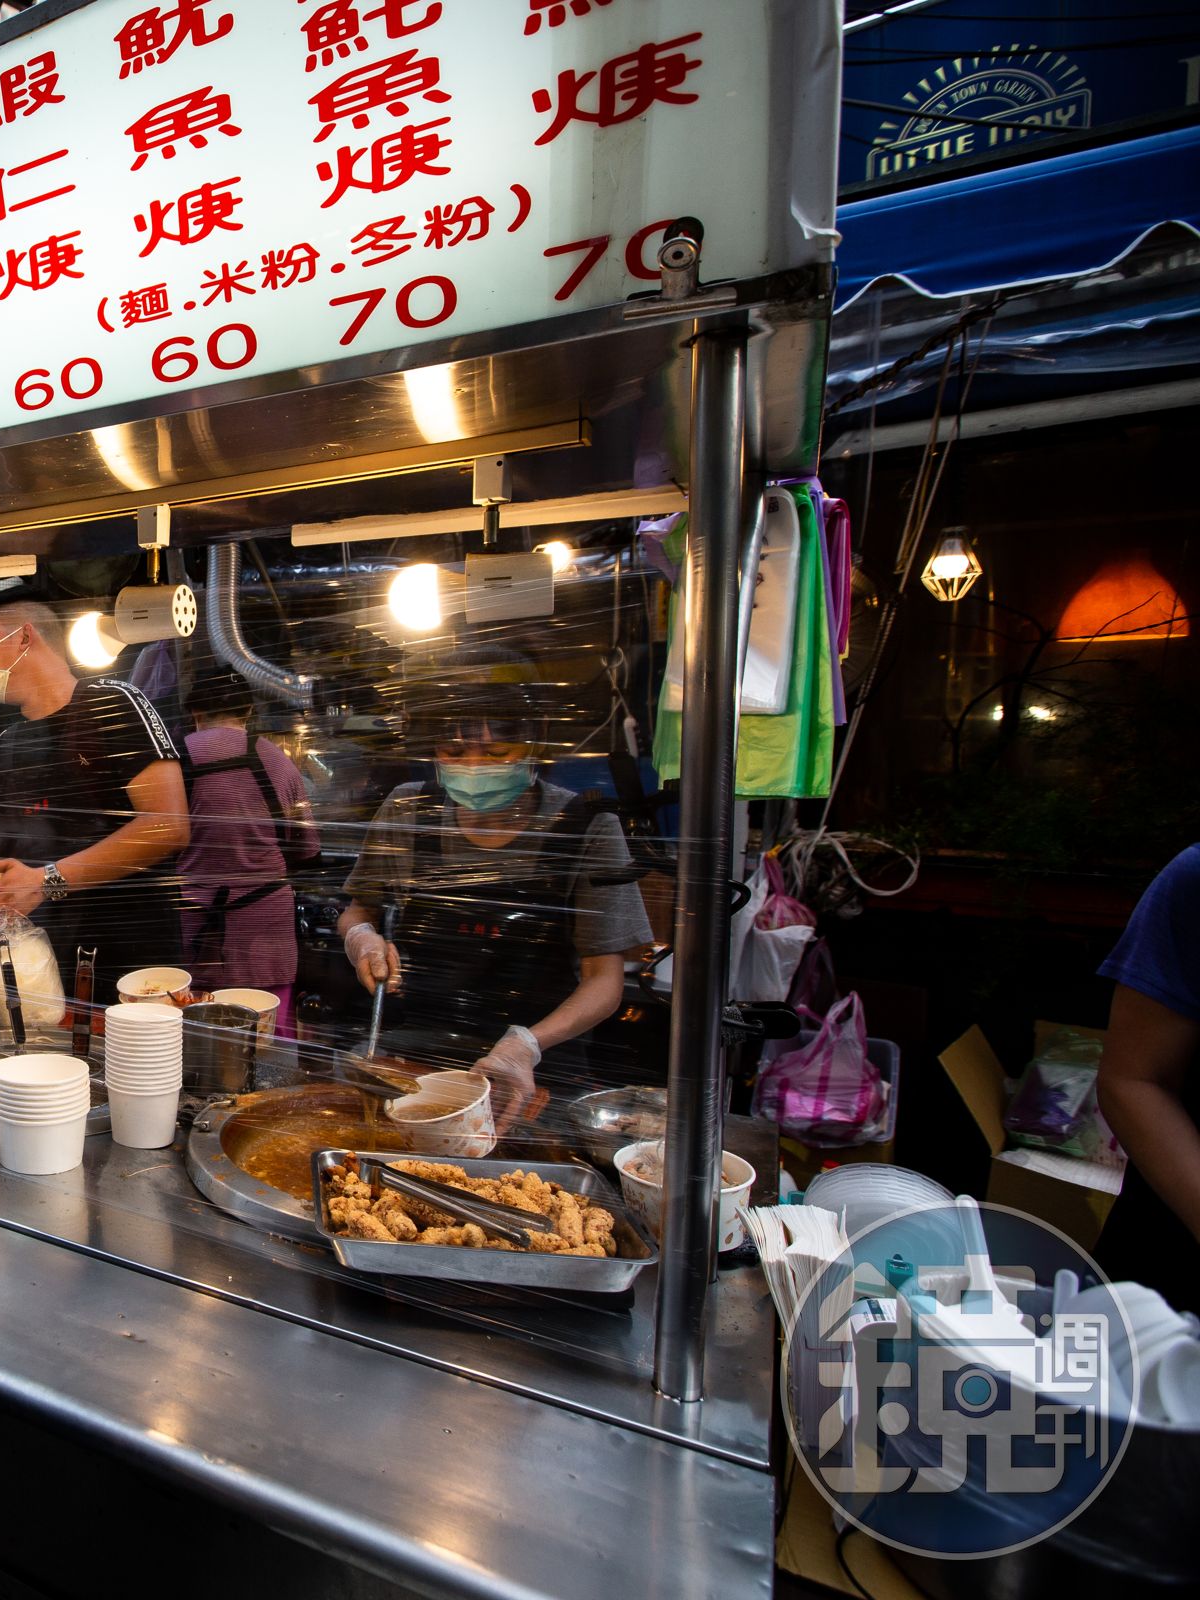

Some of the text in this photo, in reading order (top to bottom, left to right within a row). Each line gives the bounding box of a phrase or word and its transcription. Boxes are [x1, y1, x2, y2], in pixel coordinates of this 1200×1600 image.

[951, 80, 989, 104] TOWN
[994, 80, 1040, 102] GARDEN
[879, 132, 975, 177] LITTLE
[113, 0, 258, 384] 魷魚焿 60
[543, 218, 702, 301] 70
[328, 275, 457, 346] 70
[13, 356, 104, 412] 60
